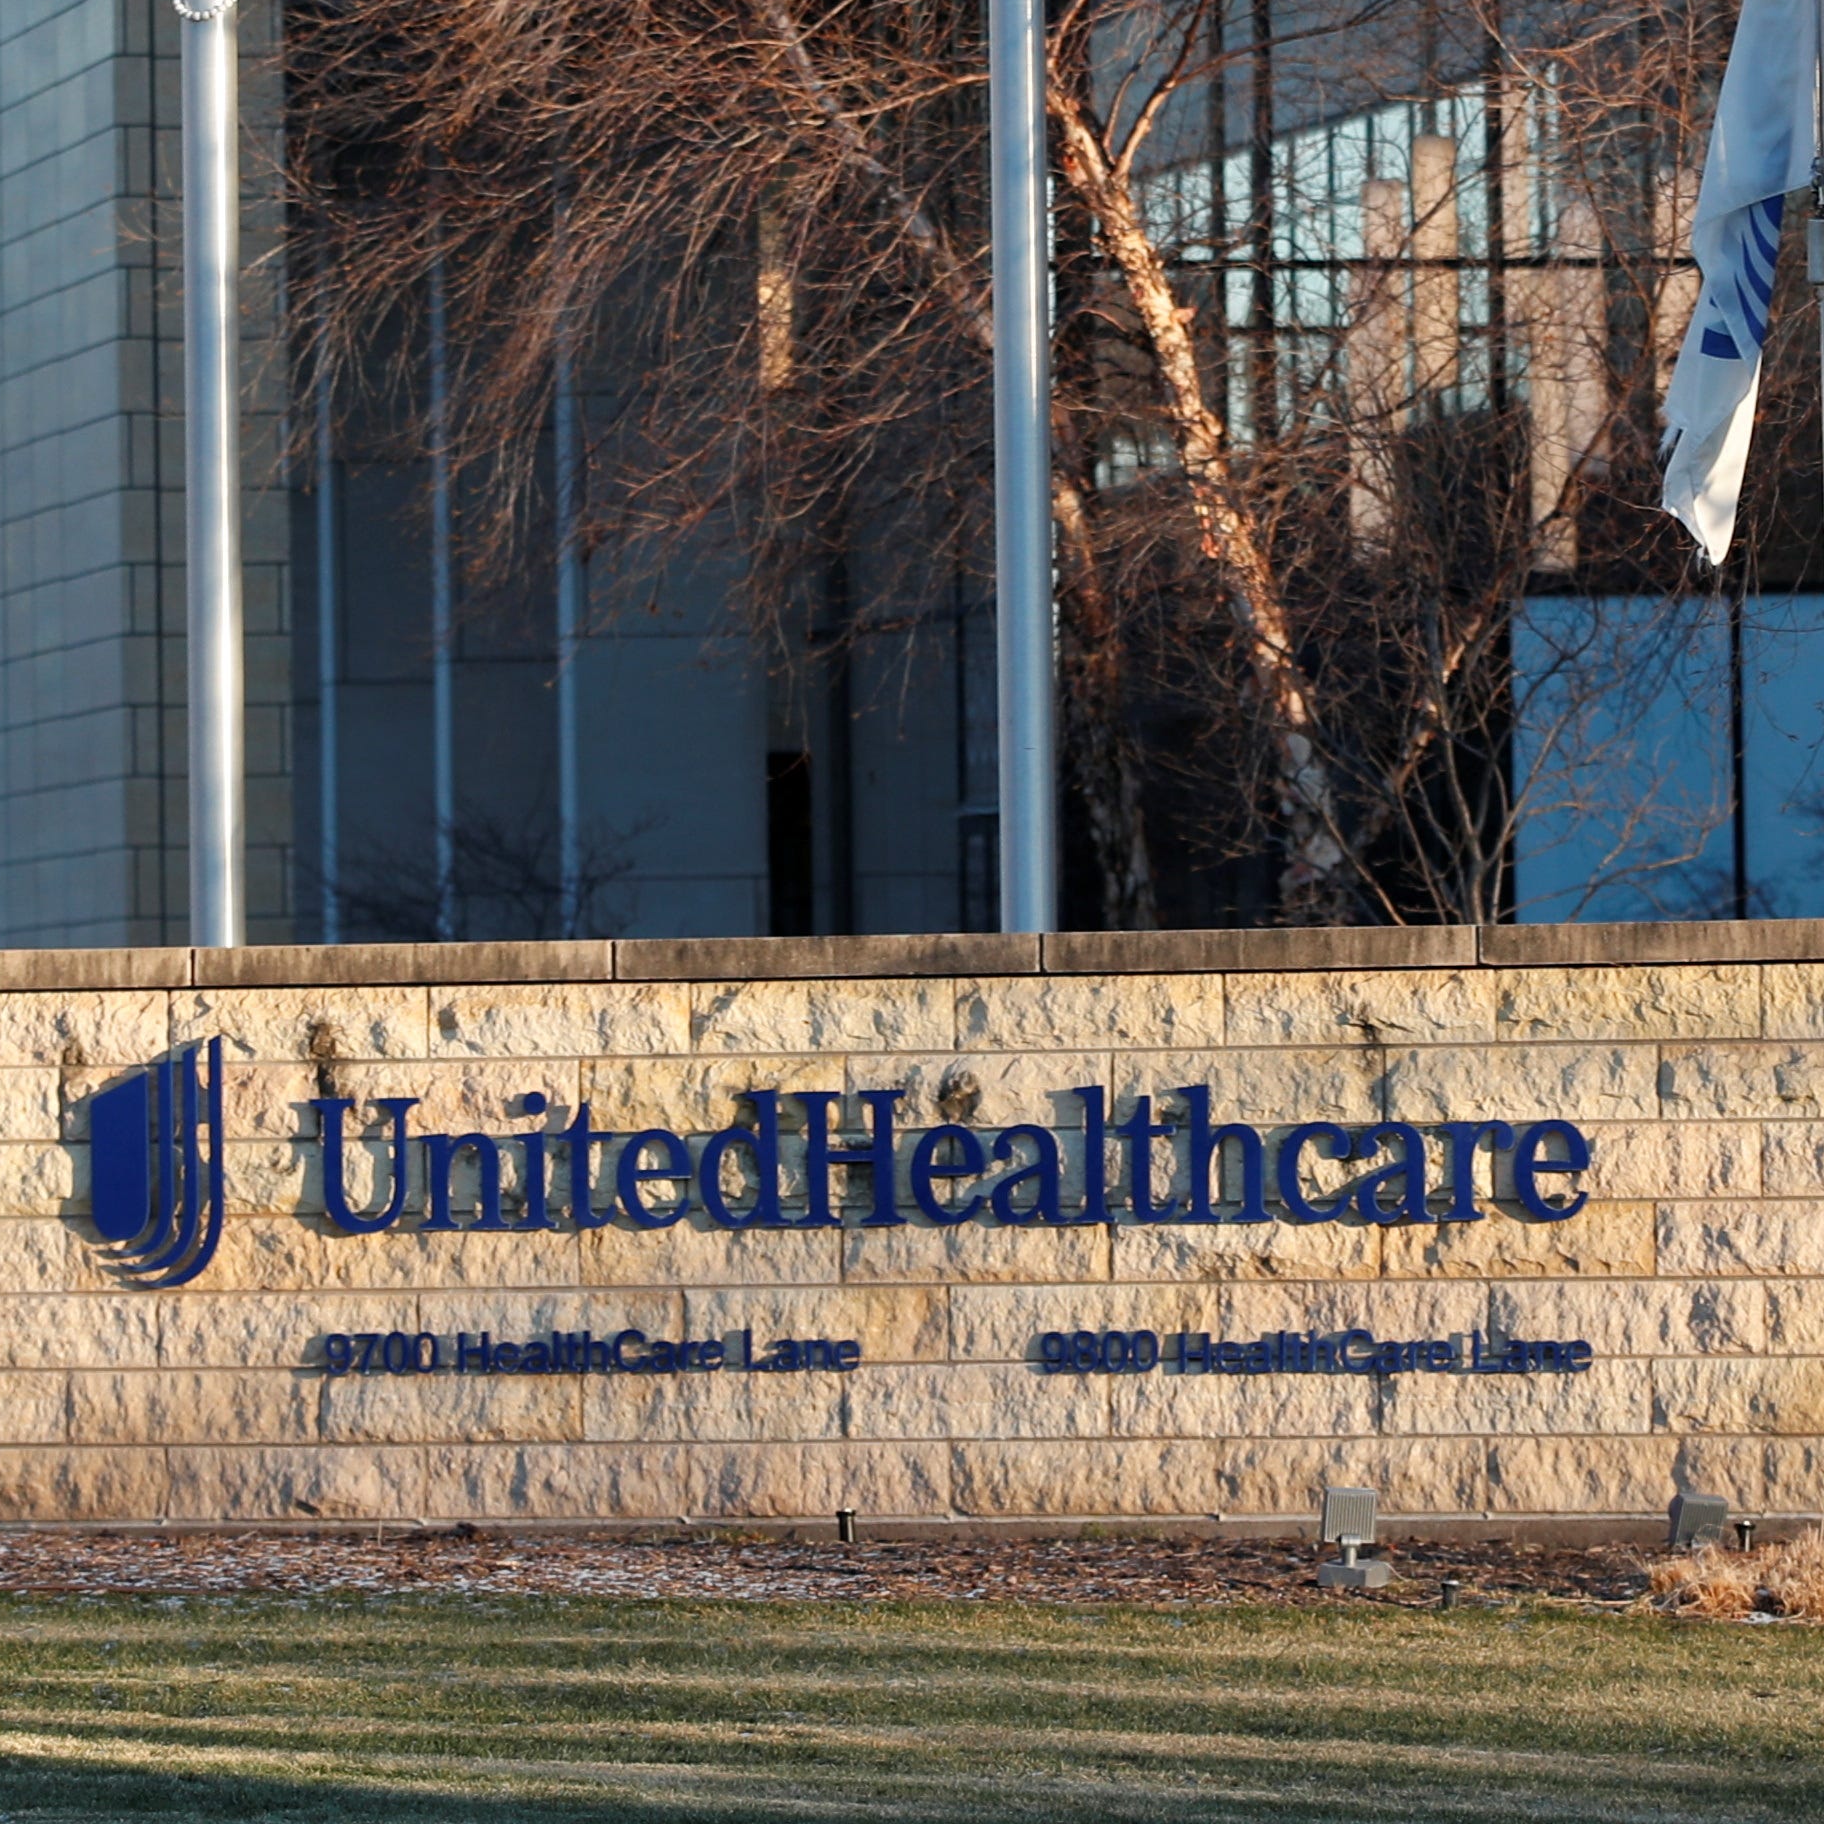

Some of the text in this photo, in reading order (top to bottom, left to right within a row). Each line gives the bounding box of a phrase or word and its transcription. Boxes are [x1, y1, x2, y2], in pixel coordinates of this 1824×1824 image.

[309, 1084, 1591, 1234] UnitedHealthcare
[324, 1328, 862, 1375] 9700 HealthCare Lane
[1038, 1328, 1594, 1375] 9800 HealthCare Lane
